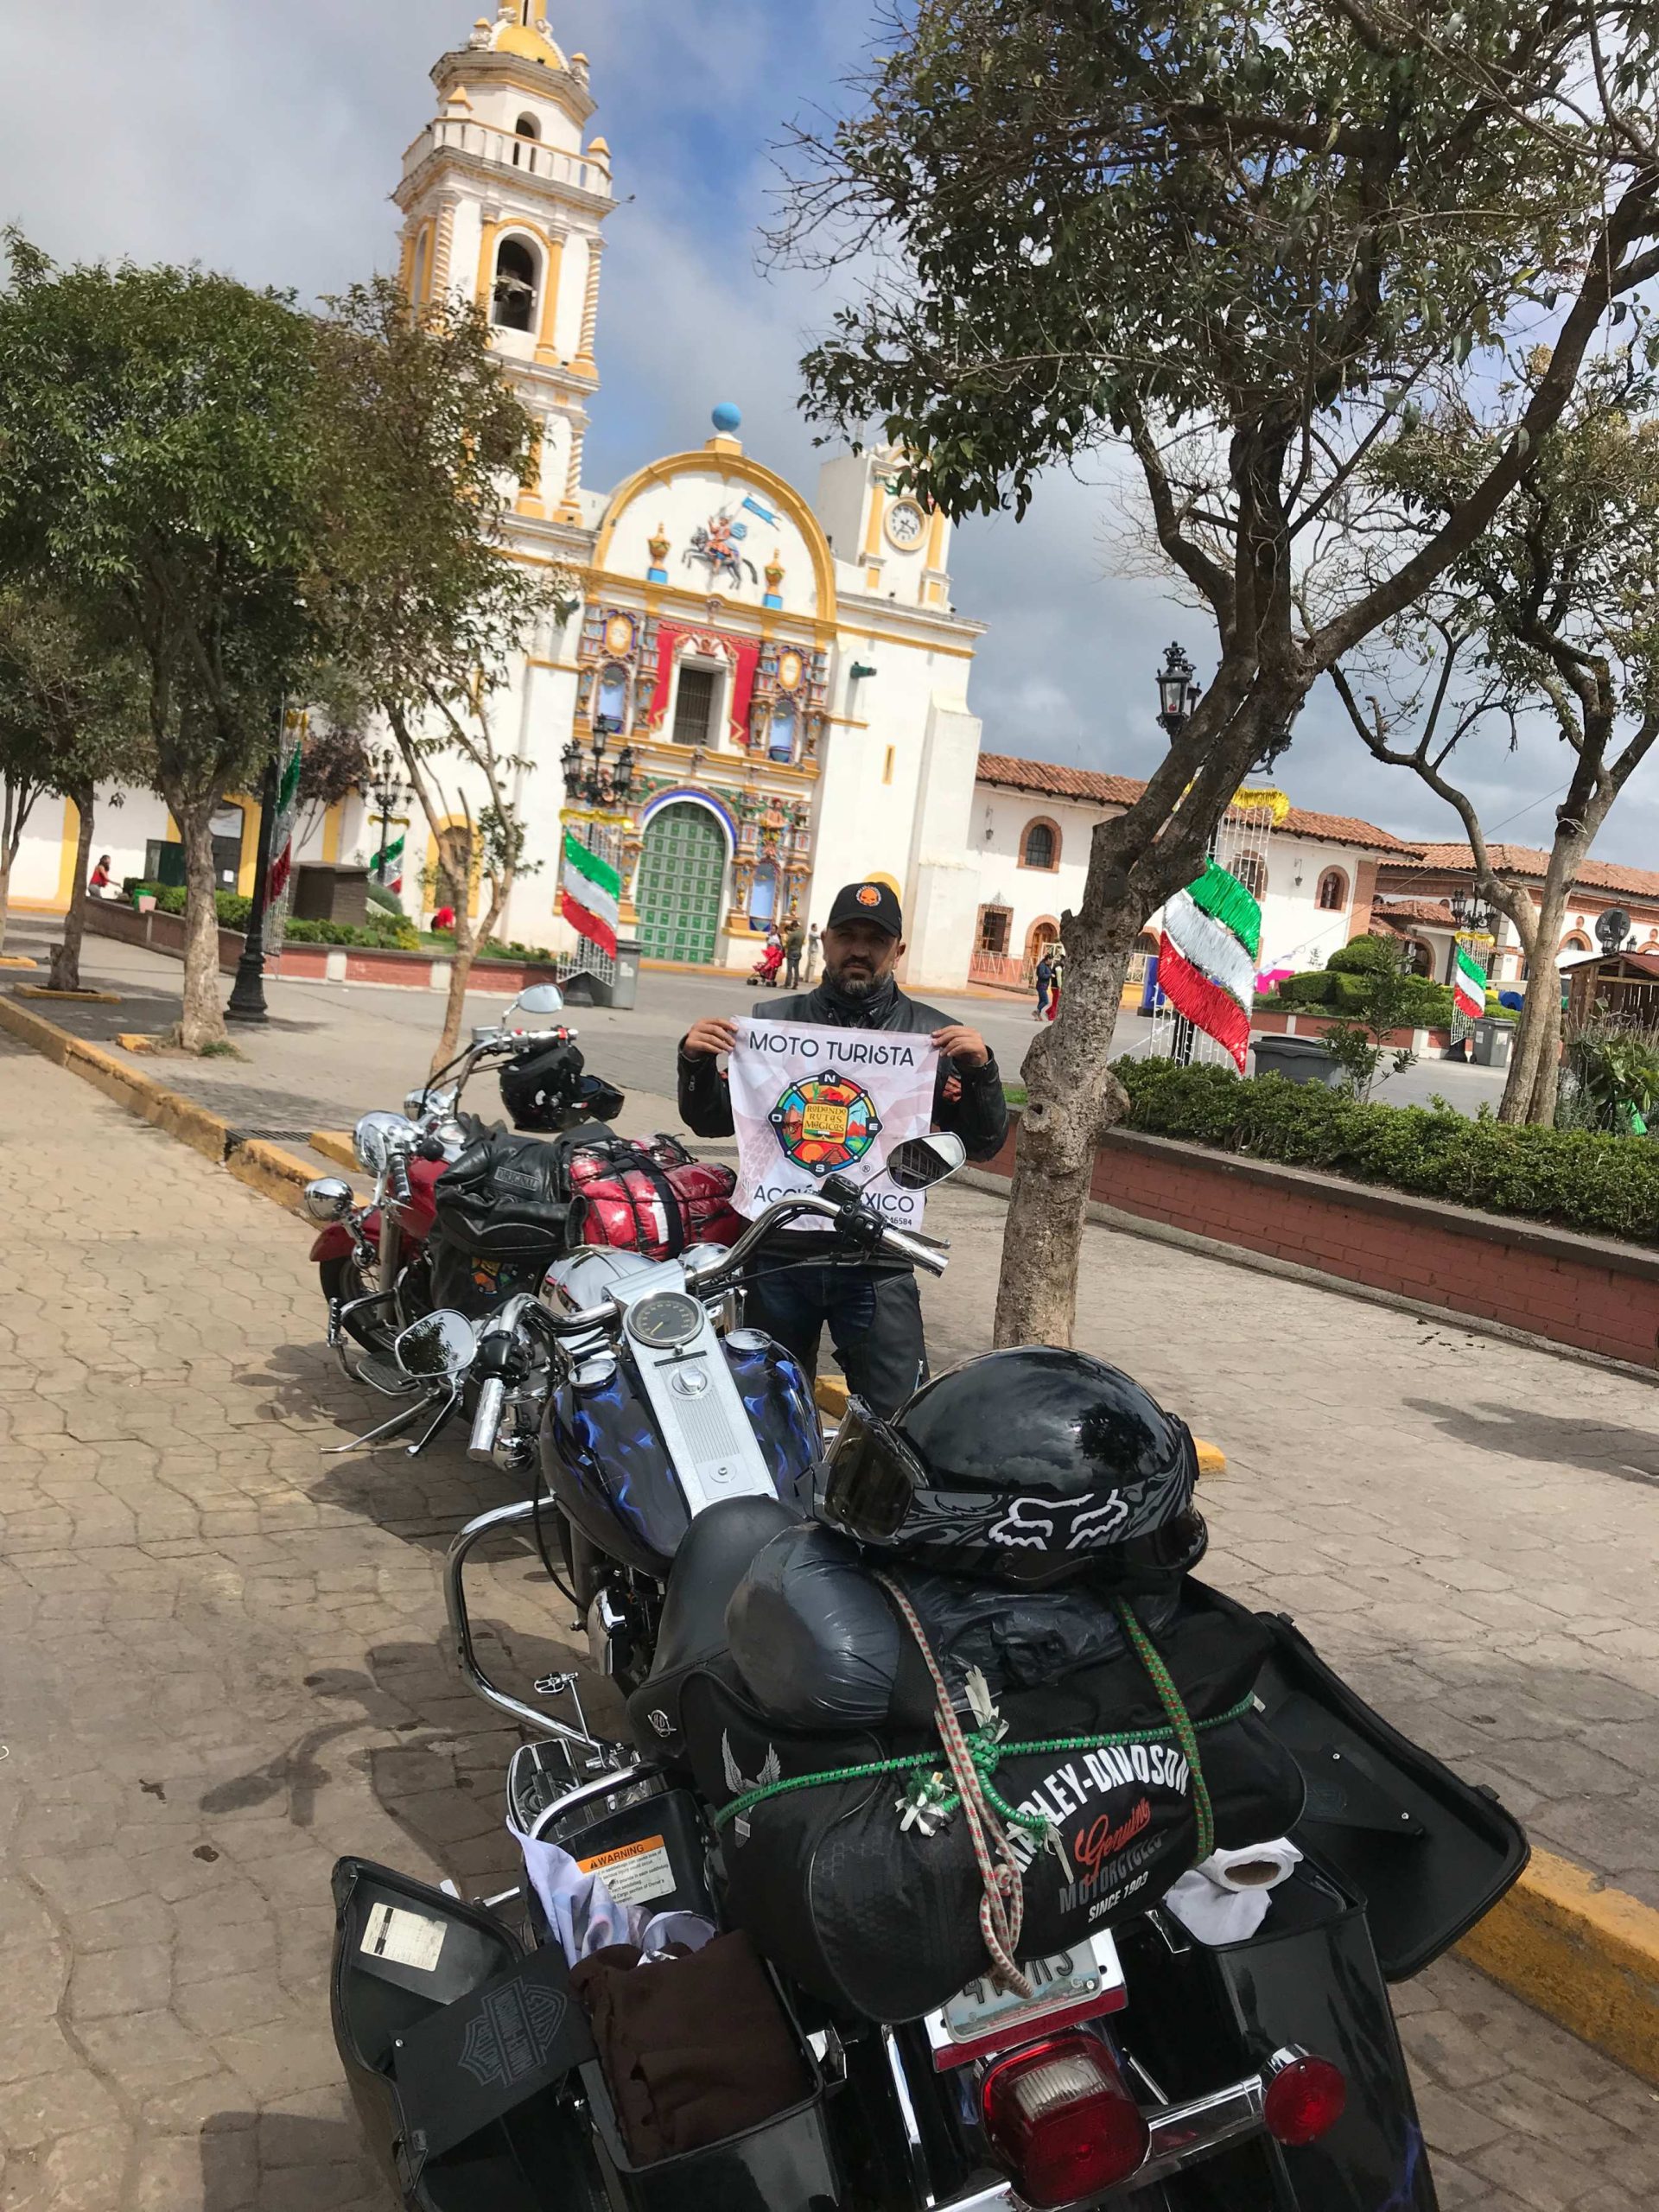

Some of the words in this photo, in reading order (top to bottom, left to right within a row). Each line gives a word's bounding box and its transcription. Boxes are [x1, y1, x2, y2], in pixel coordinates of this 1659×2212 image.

[749, 1031, 819, 1058] MOTO
[826, 1041, 914, 1067] TURISTA
[823, 1074, 836, 1084] N
[772, 1113, 782, 1122] O
[868, 1122, 878, 1131] E
[815, 1164, 825, 1173] S
[864, 1192, 914, 1213] XICO
[597, 1843, 645, 1867] WARNING
[1088, 1889, 1122, 1923] SINCE
[1123, 1871, 1149, 1899] 1903
